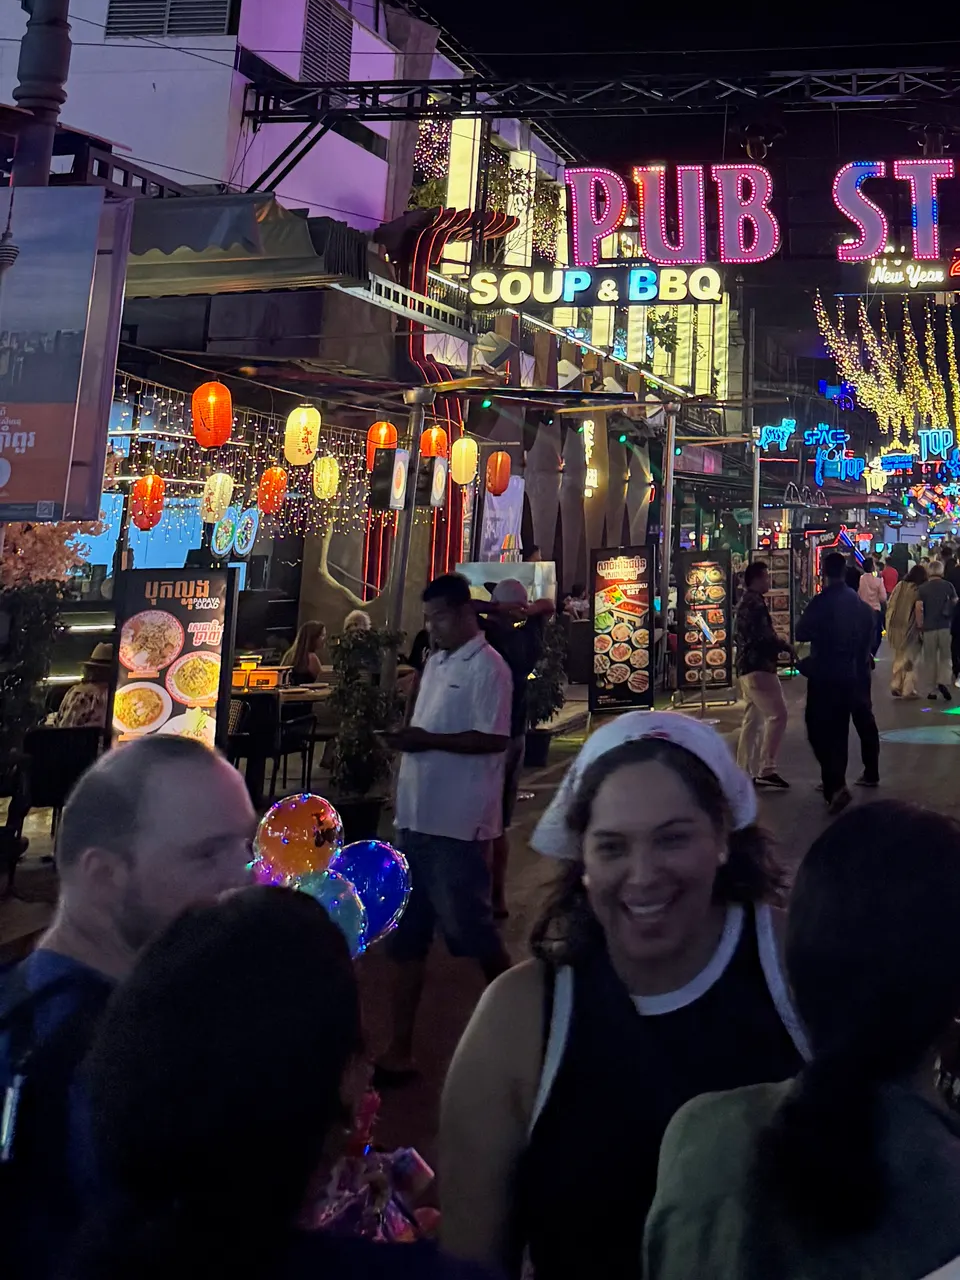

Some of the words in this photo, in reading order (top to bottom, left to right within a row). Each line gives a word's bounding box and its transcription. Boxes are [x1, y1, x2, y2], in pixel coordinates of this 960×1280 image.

[564, 164, 781, 267] PUB
[469, 270, 592, 306] SOUP
[597, 279, 620, 302] &
[628, 267, 722, 302] BBQ
[870, 265, 905, 284] New
[906, 264, 945, 288] Year
[803, 429, 845, 445] SPACE
[818, 422, 830, 431] the
[918, 429, 954, 462] TOP
[840, 458, 865, 481] TOP
[195, 602, 219, 610] SALAD
